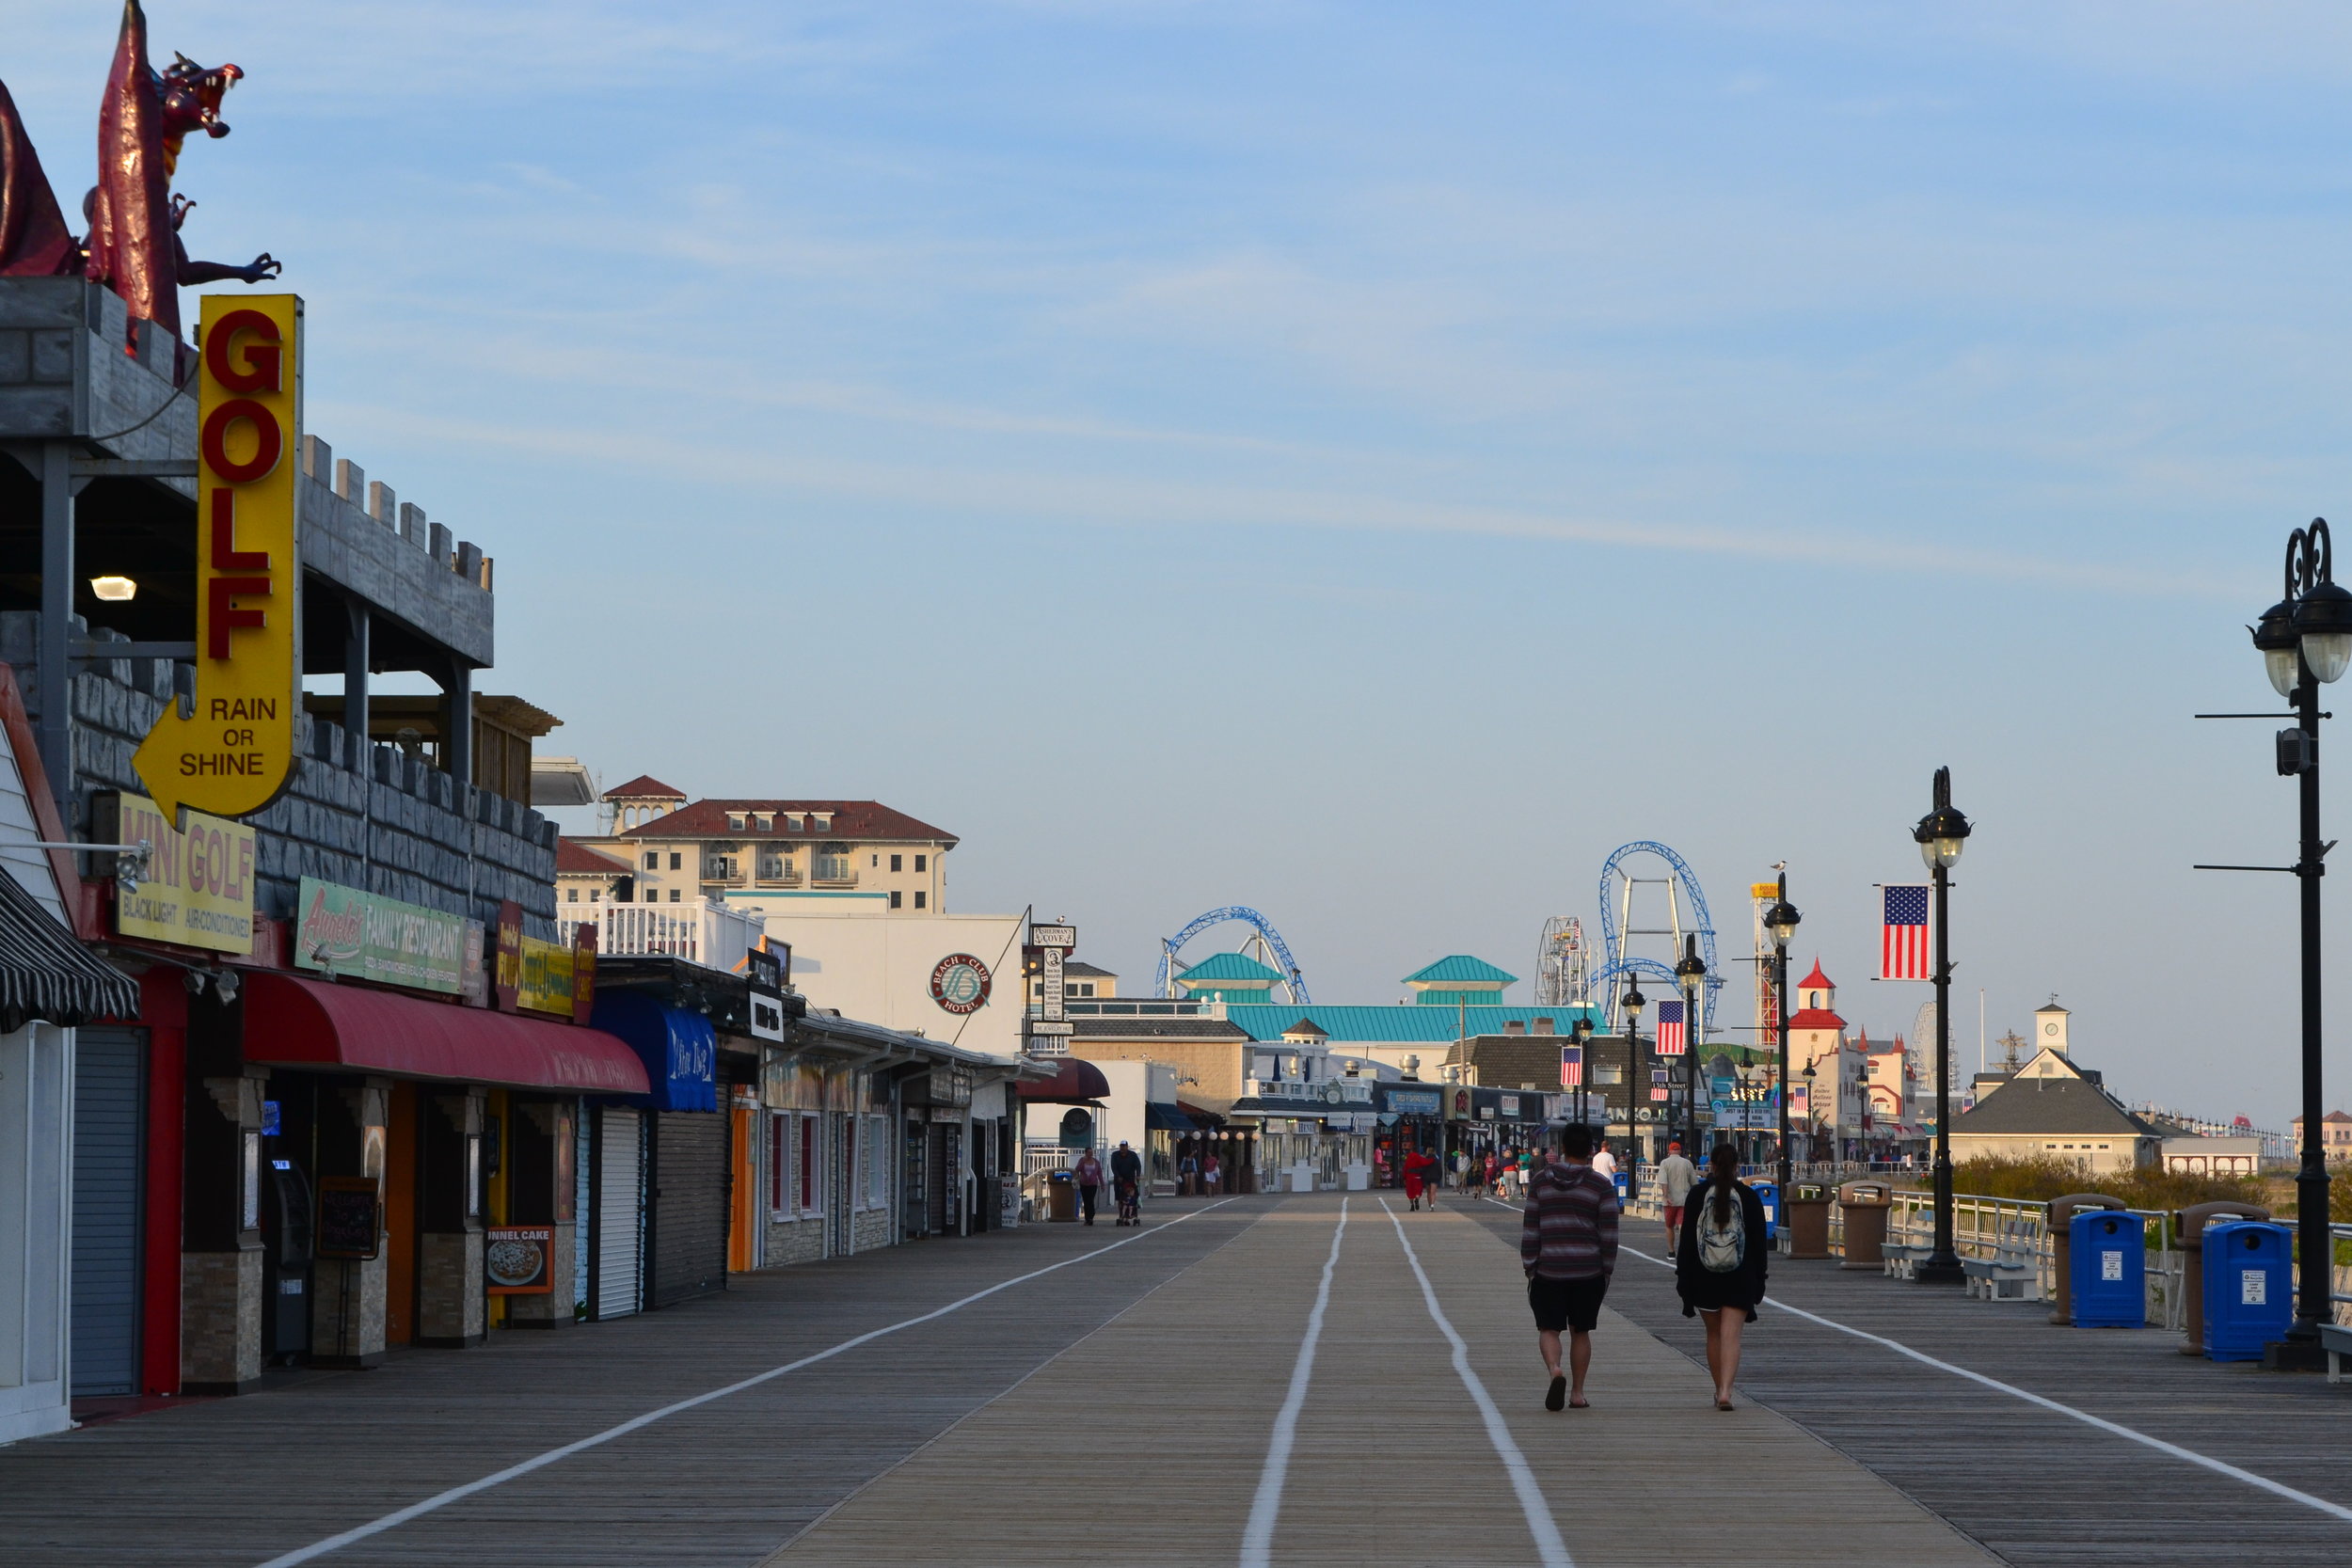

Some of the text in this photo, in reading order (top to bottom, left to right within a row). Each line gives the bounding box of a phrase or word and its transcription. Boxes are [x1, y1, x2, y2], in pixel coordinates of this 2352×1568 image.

[201, 309, 283, 660] GOLF
[211, 698, 277, 721] RAIN
[223, 729, 254, 747] OR
[179, 752, 264, 776] SHINE
[122, 806, 253, 902] MINI GOLF
[123, 895, 151, 921] BLACK
[153, 900, 178, 926] LIGHT
[366, 904, 403, 950] FAMILY
[402, 913, 460, 962] RESTAURANT
[933, 956, 989, 984] BEACH CLUB
[944, 1000, 978, 1013] HOTEL
[488, 1230, 549, 1240] NNEL CAKE
